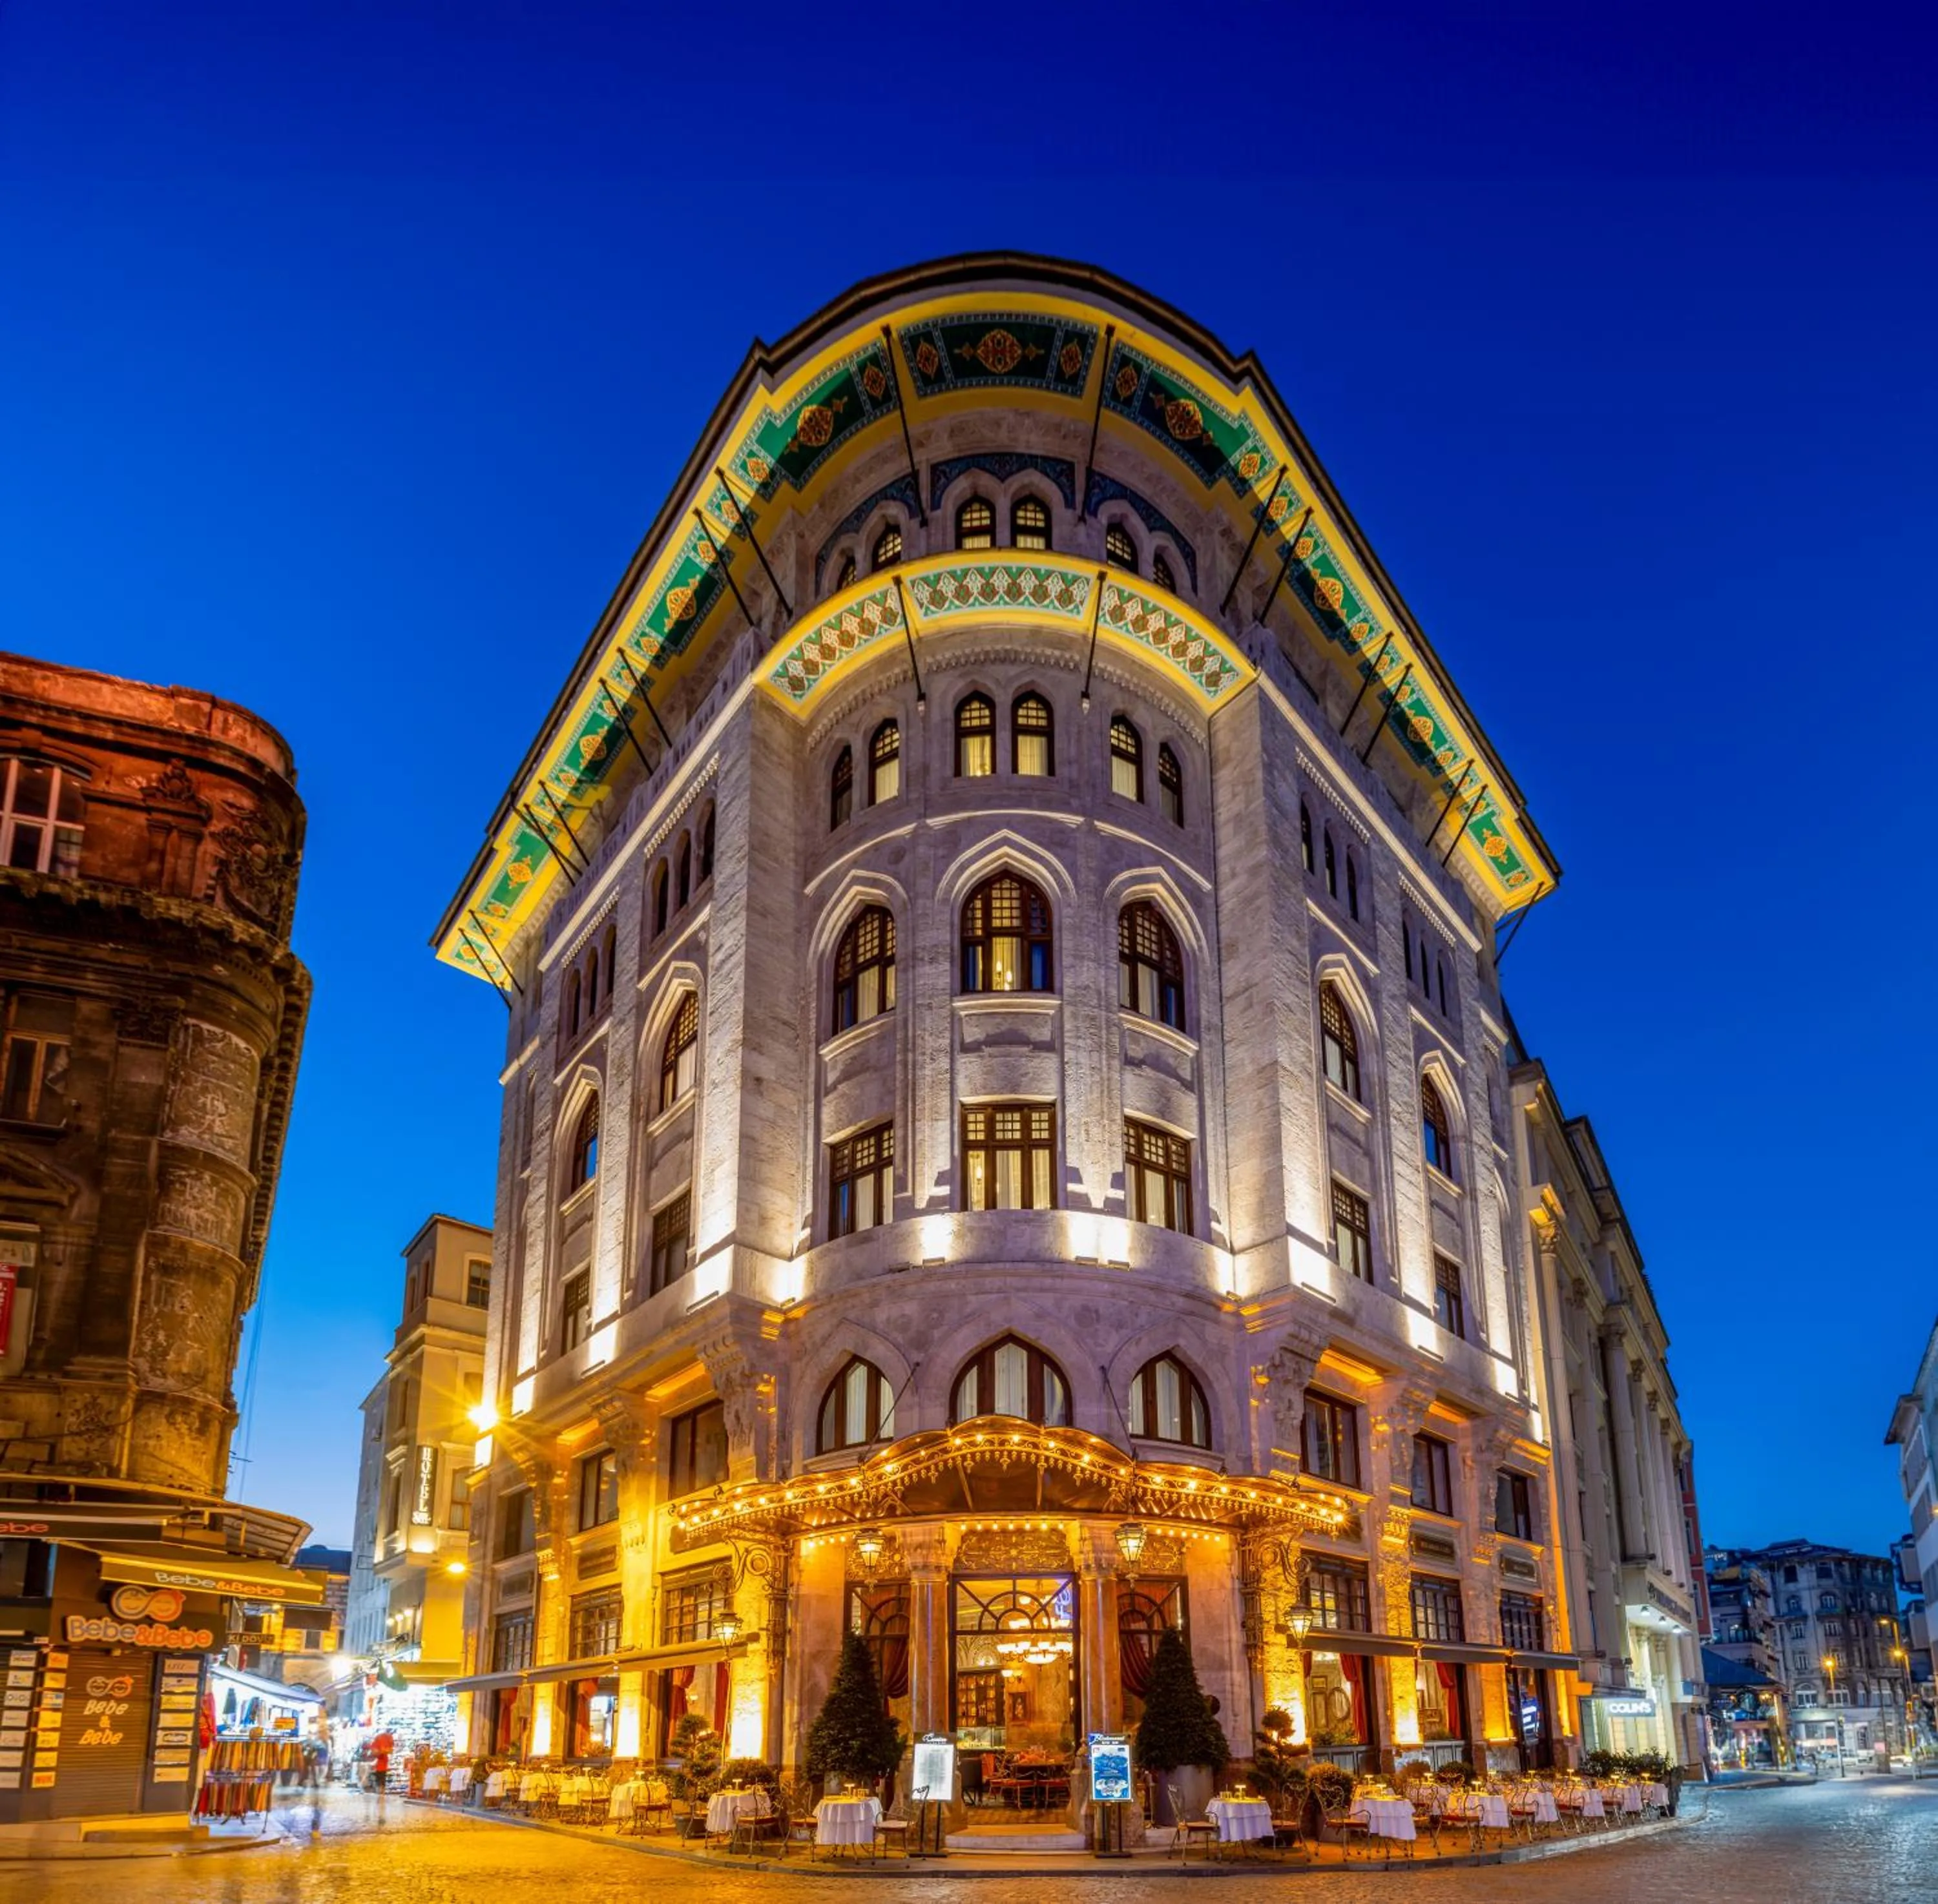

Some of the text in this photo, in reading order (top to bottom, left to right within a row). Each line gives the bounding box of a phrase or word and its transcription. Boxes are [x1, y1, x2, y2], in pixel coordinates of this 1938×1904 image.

[419, 1447, 432, 1511] HOTEL
[154, 1571, 286, 1597] Bebe&Bebe
[67, 1615, 214, 1649] Bebe&Bebe
[83, 1699, 129, 1715] Bebe
[78, 1728, 124, 1745] Bebe
